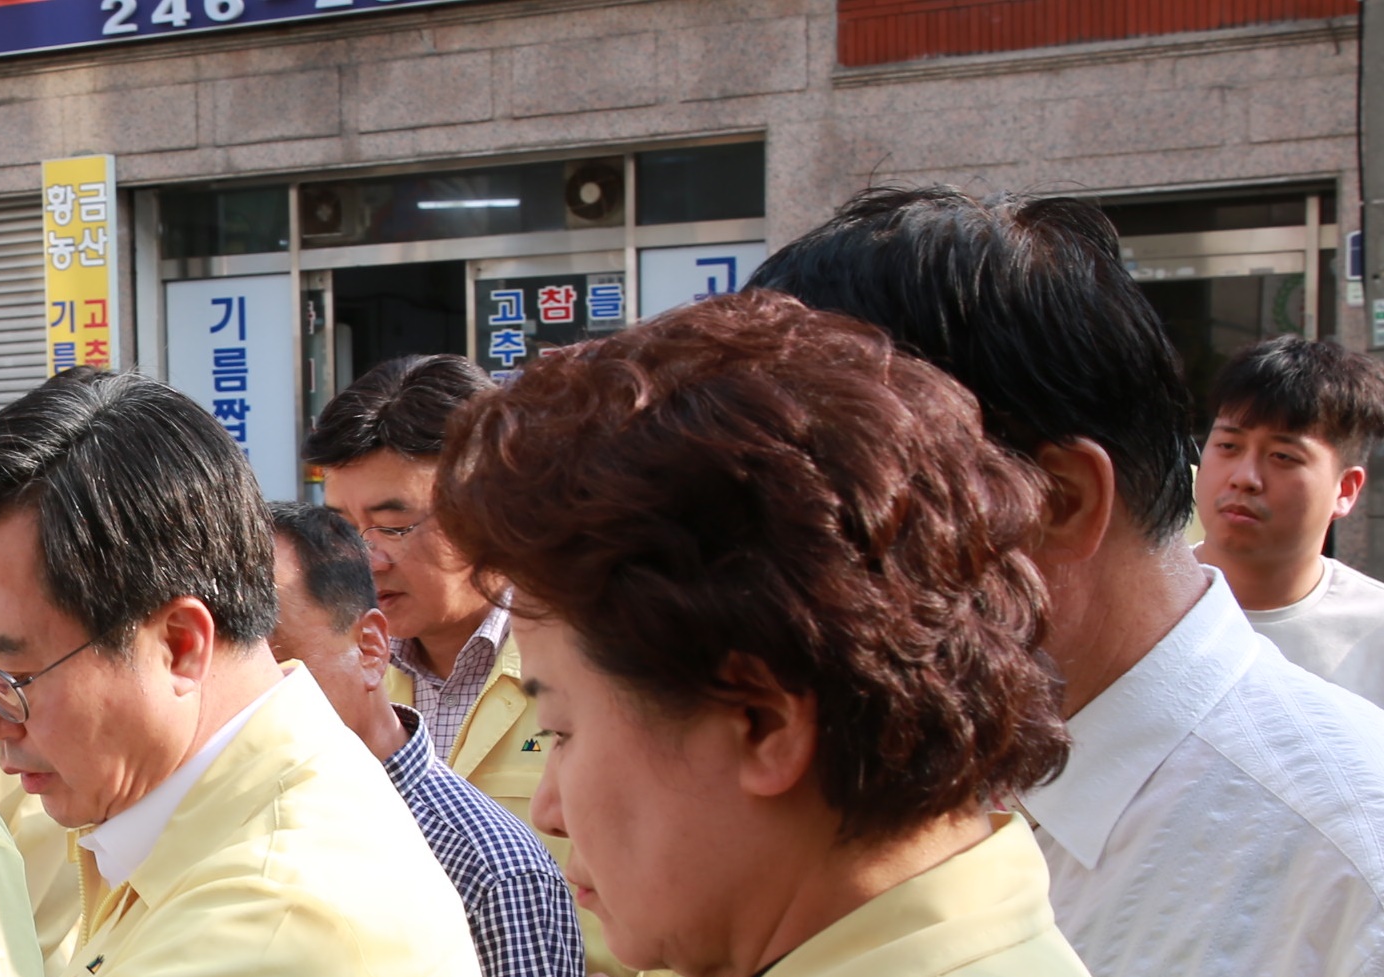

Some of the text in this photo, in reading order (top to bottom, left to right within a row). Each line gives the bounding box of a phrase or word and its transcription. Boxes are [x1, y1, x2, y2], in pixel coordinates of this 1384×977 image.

[100, 0, 245, 35] 246
[46, 183, 107, 226] 황금
[47, 227, 107, 270] 농산
[51, 300, 76, 375] 기름
[83, 299, 110, 368] 고추
[209, 296, 251, 460] 기름짭
